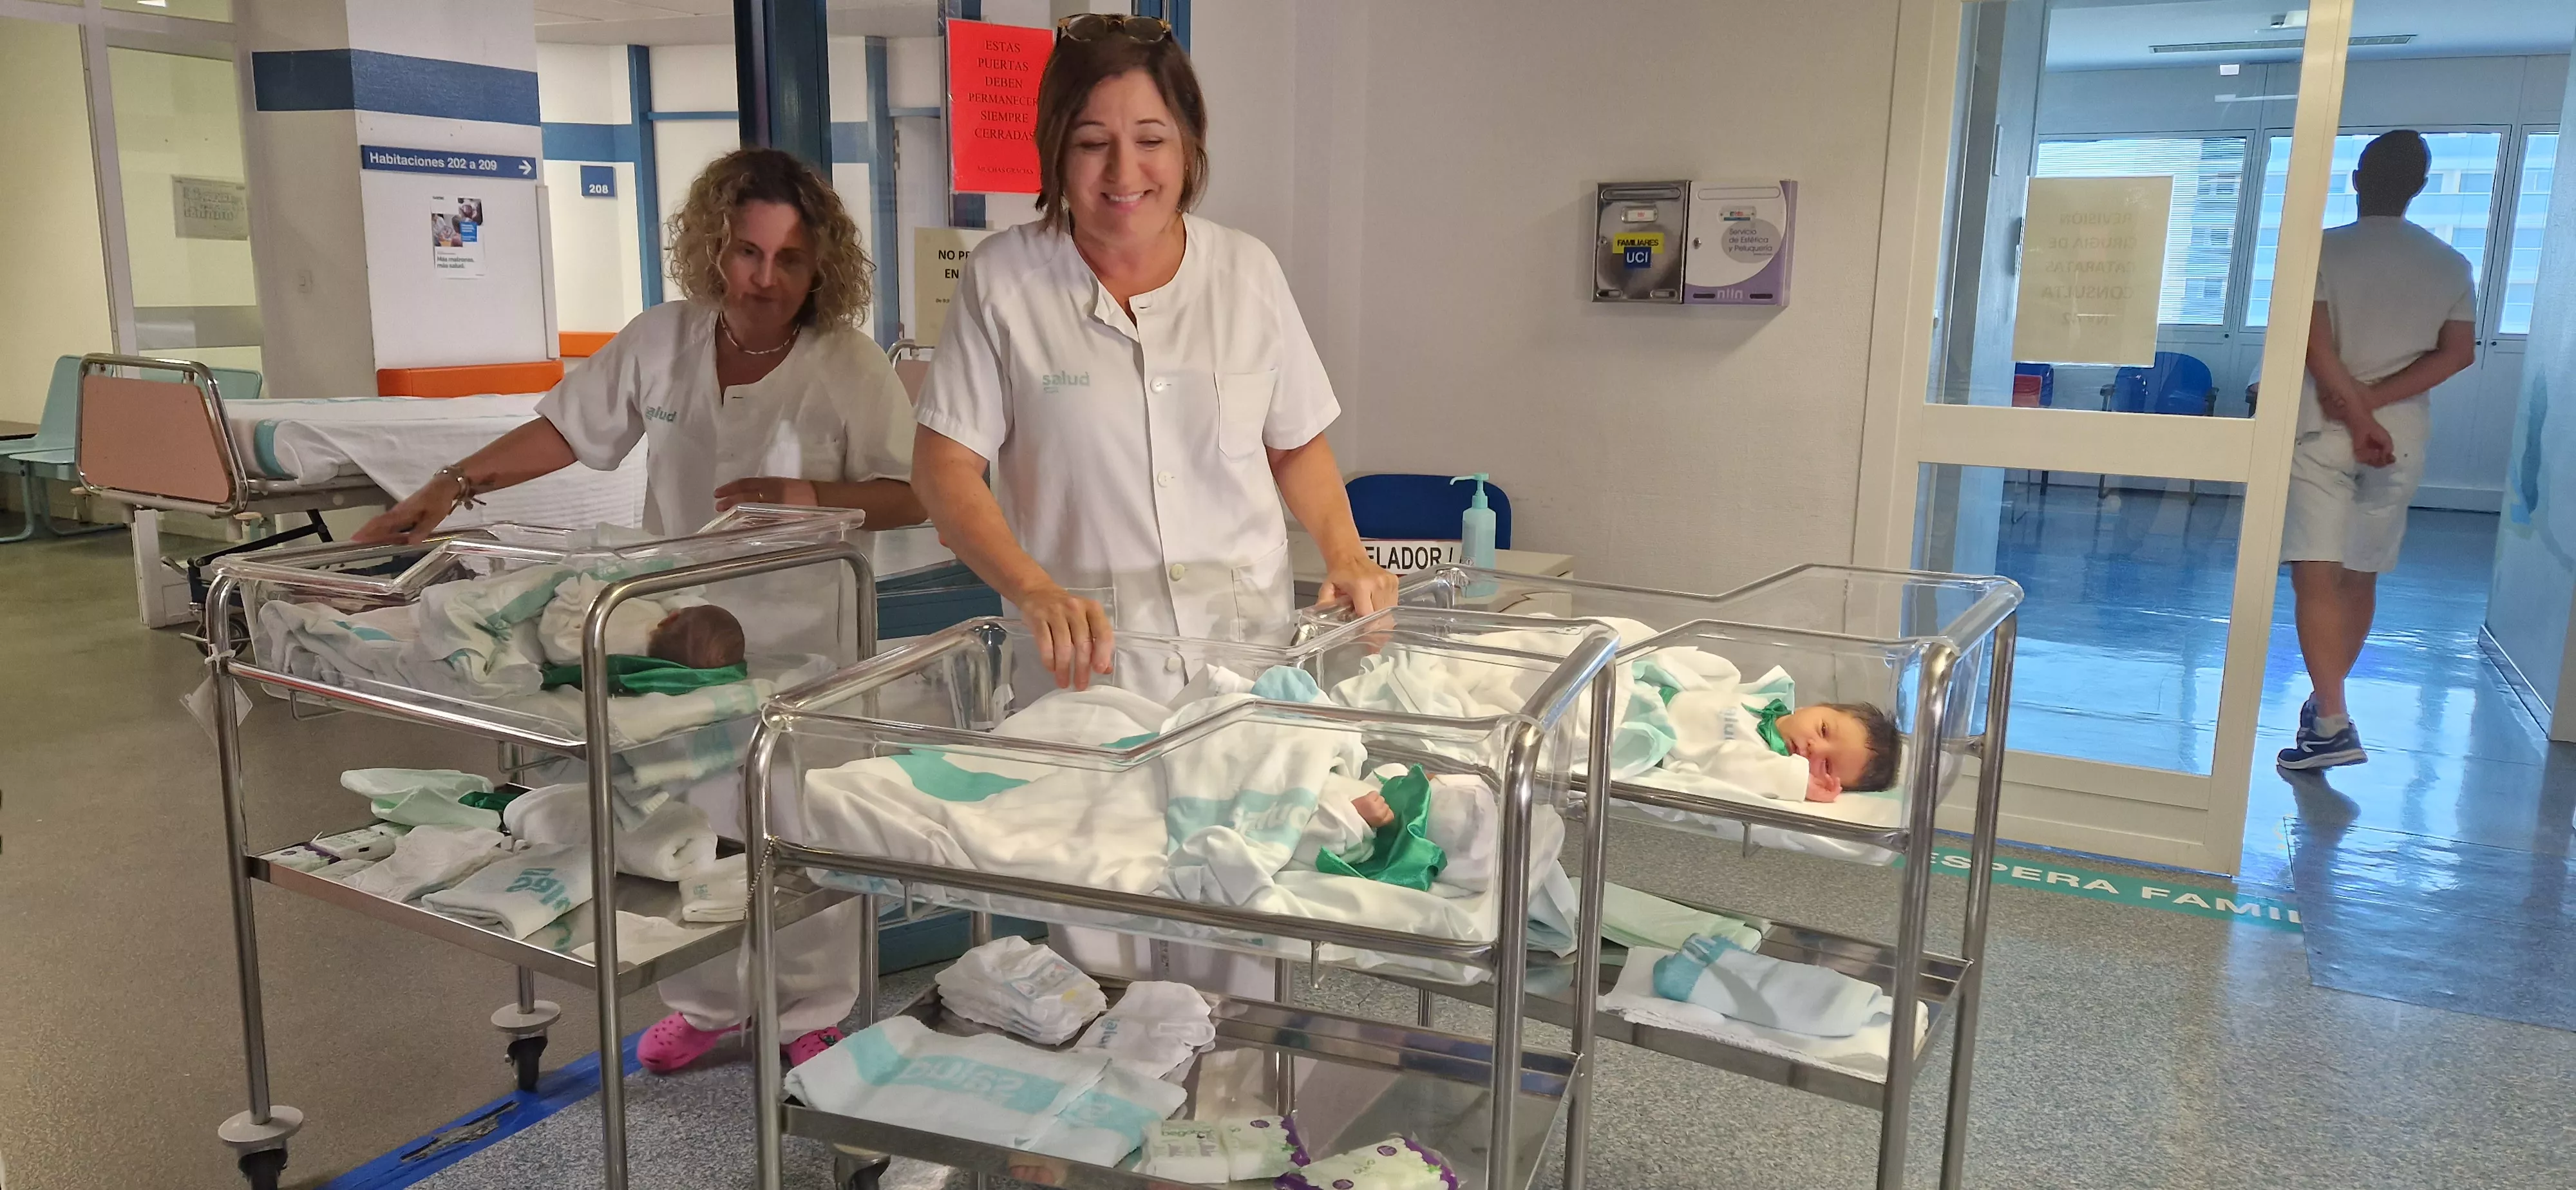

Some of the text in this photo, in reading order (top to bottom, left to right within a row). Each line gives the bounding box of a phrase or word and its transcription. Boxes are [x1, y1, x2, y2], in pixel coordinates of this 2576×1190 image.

[985, 39, 1021, 53] ESTAS
[977, 57, 1029, 72] PUERTAS
[985, 76, 1023, 90] DEBEN
[980, 110, 1029, 124] SIEMPRE
[369, 152, 498, 171] Habitaciones 202 a 209
[589, 184, 609, 194] 208
[1616, 238, 1660, 247] FAMILIARES
[1734, 245, 1773, 253] Peluquería
[938, 250, 956, 260] NO
[1626, 252, 1649, 263] UCI
[945, 269, 959, 279] EN
[1043, 370, 1090, 386] salud
[1930, 852, 2120, 894] SERA
